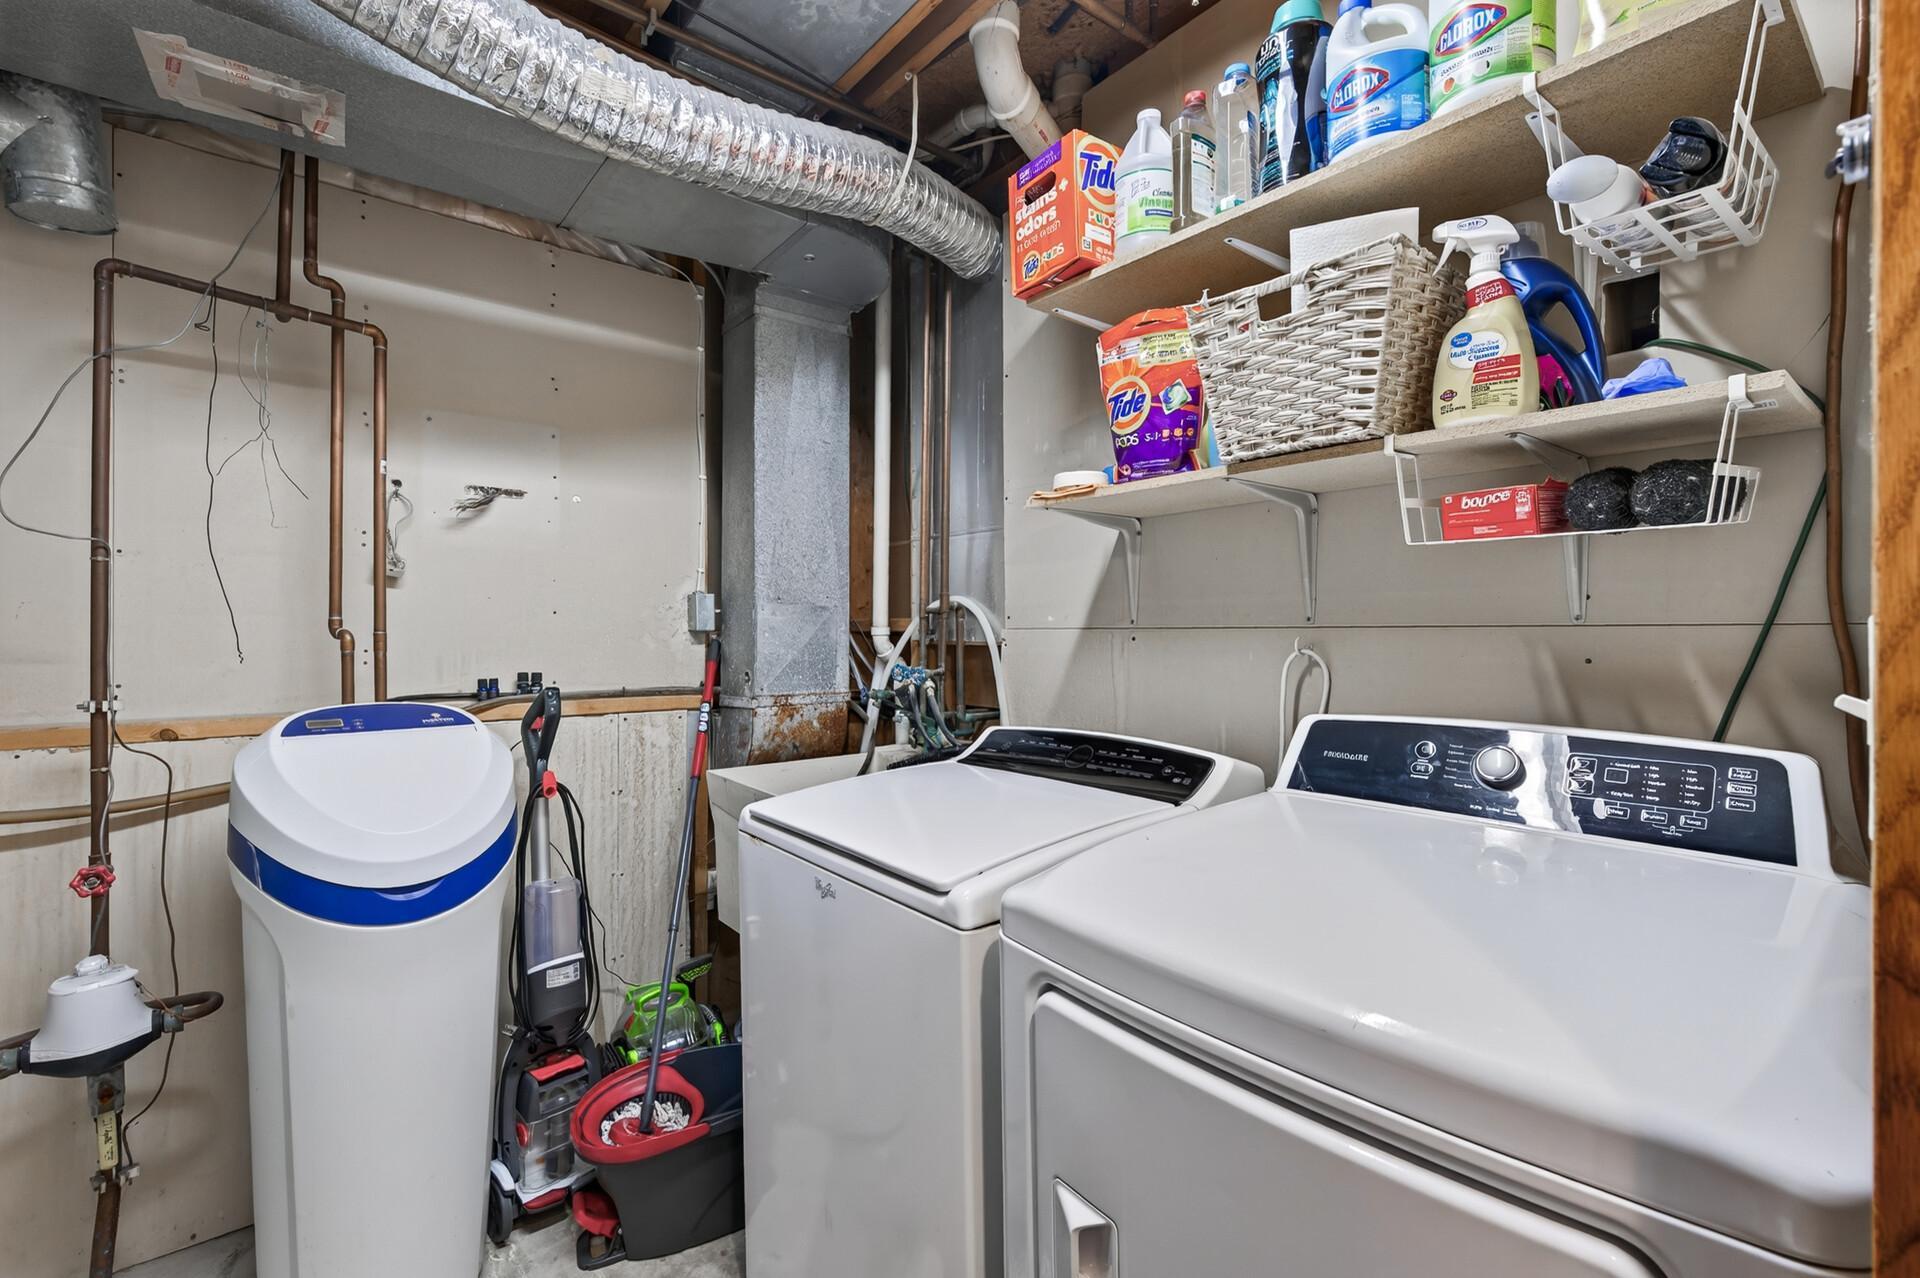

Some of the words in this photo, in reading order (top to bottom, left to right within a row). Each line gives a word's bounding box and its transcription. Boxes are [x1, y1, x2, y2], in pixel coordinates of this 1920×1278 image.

[1439, 7, 1497, 52] CLOROX
[1333, 71, 1379, 109] CLOROX
[1016, 205, 1057, 242] odors
[1107, 387, 1147, 424] Tide
[1461, 489, 1511, 509] bounce
